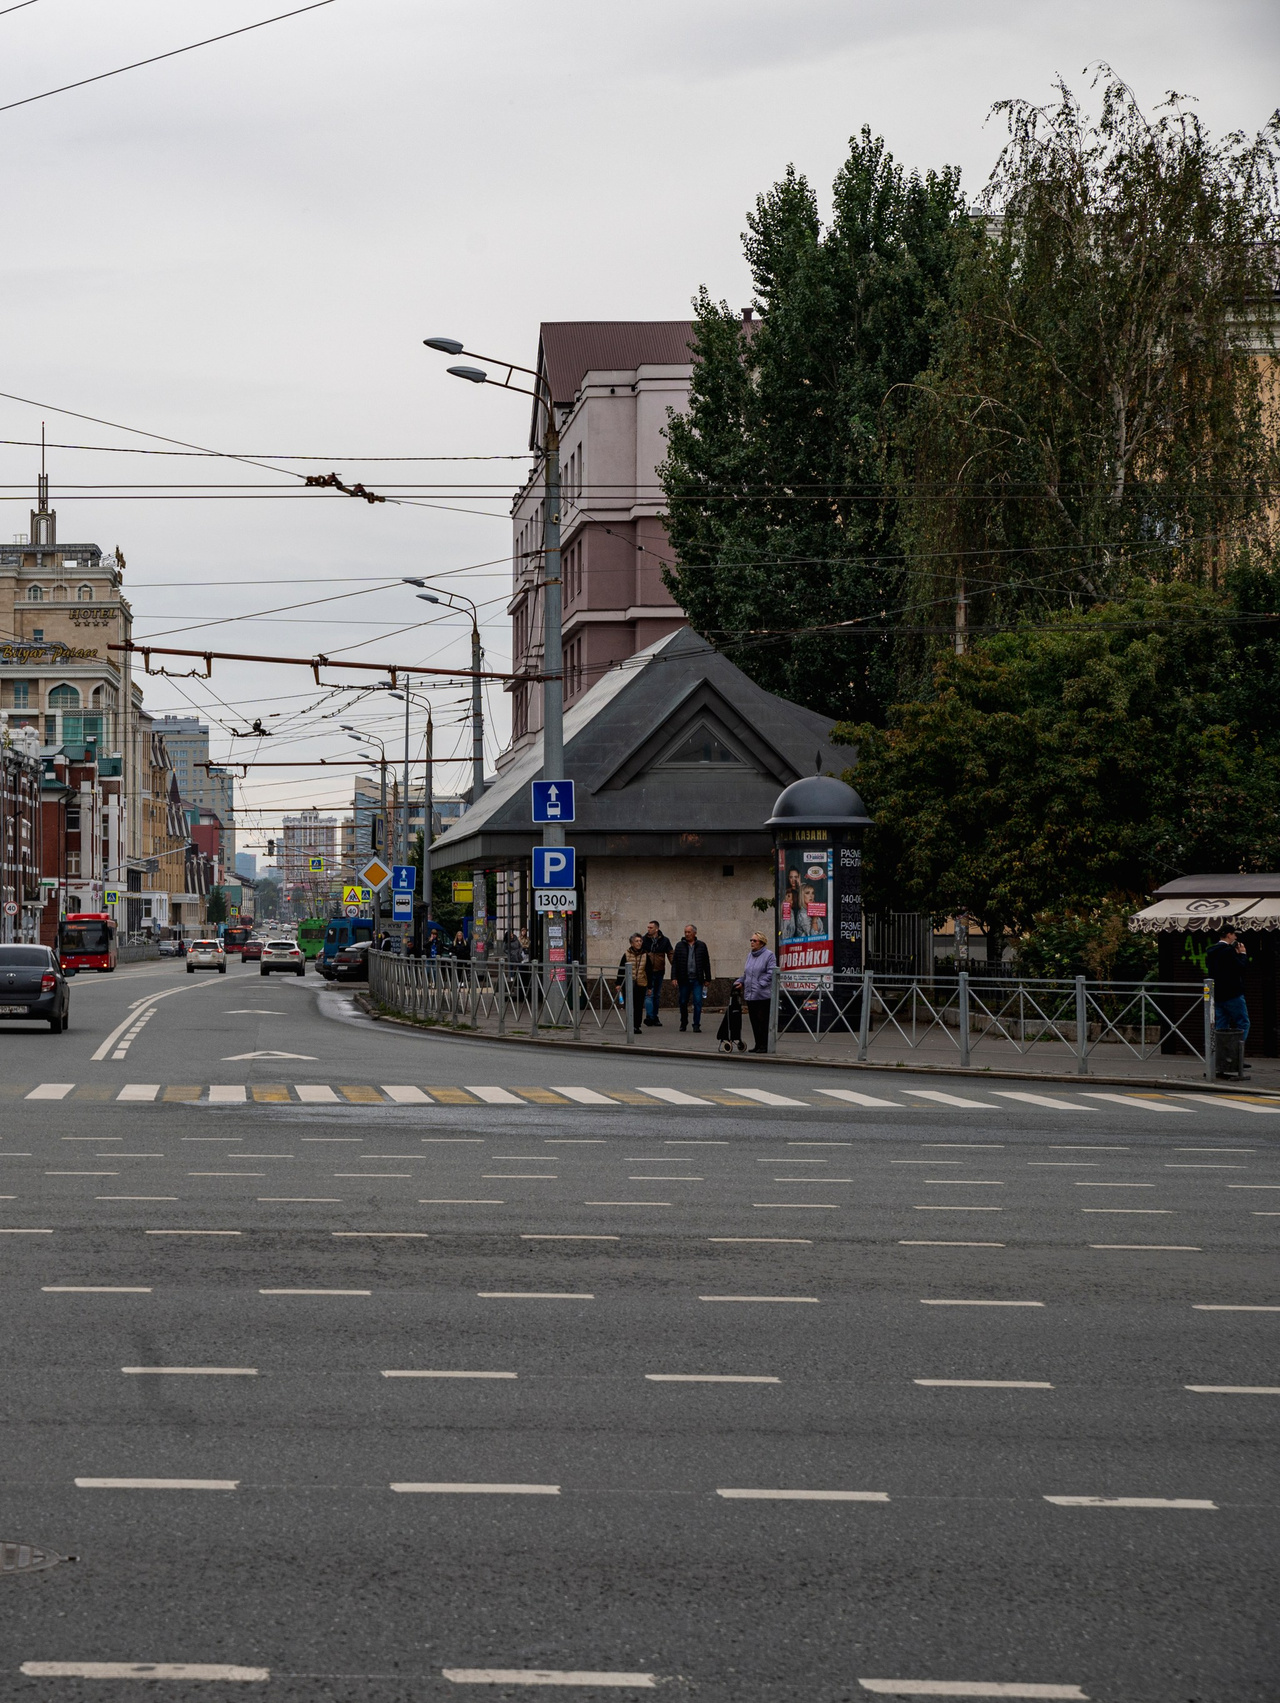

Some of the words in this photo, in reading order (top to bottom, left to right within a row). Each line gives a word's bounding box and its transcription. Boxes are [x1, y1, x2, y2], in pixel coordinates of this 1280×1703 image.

[68, 608, 117, 620] HOTEL
[2, 644, 47, 664] Bilyar
[51, 647, 98, 662] Palace
[795, 829, 827, 841] КАЗАНИ
[537, 894, 567, 907] 1300
